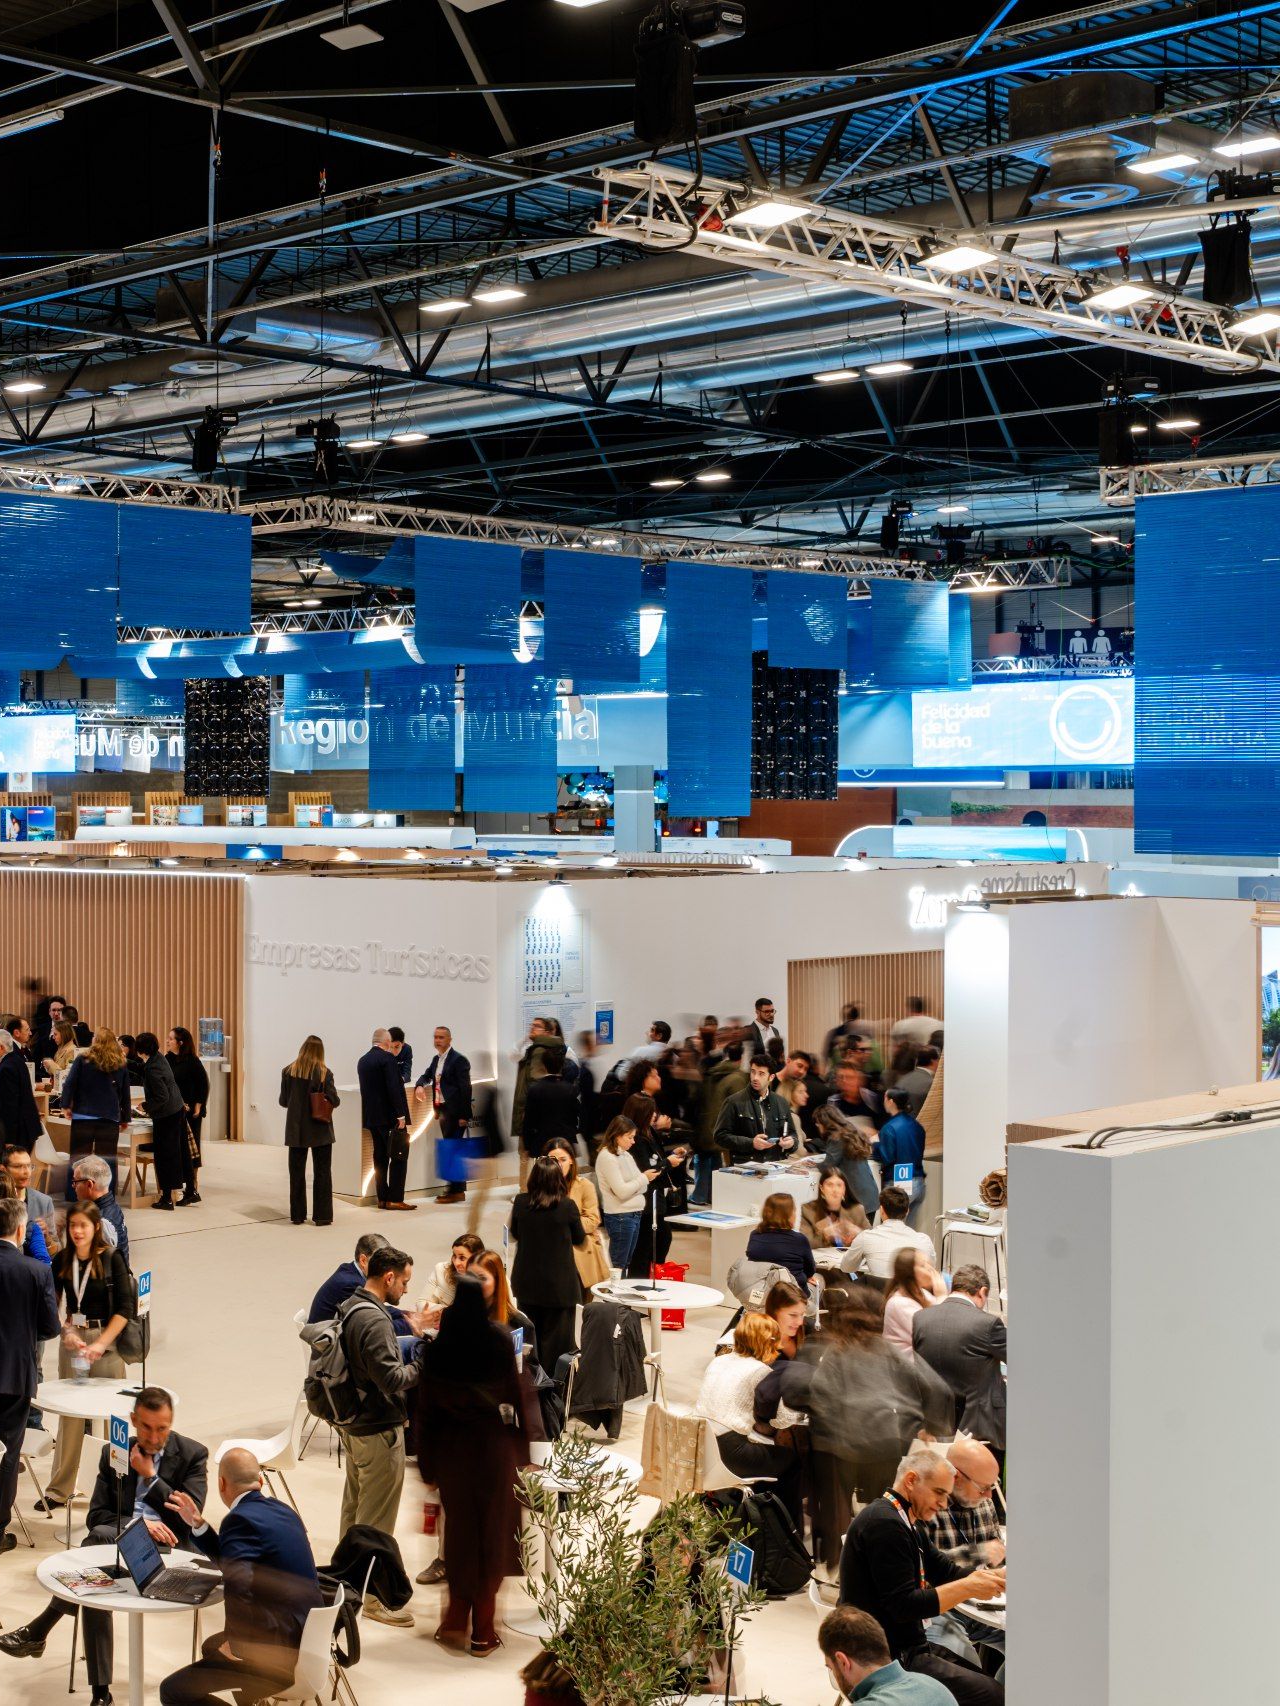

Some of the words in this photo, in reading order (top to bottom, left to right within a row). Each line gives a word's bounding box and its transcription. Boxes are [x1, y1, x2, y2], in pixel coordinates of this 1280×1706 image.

[247, 932, 362, 977] Empresas
[366, 940, 491, 984] Turísticas
[112, 1421, 126, 1444] 06
